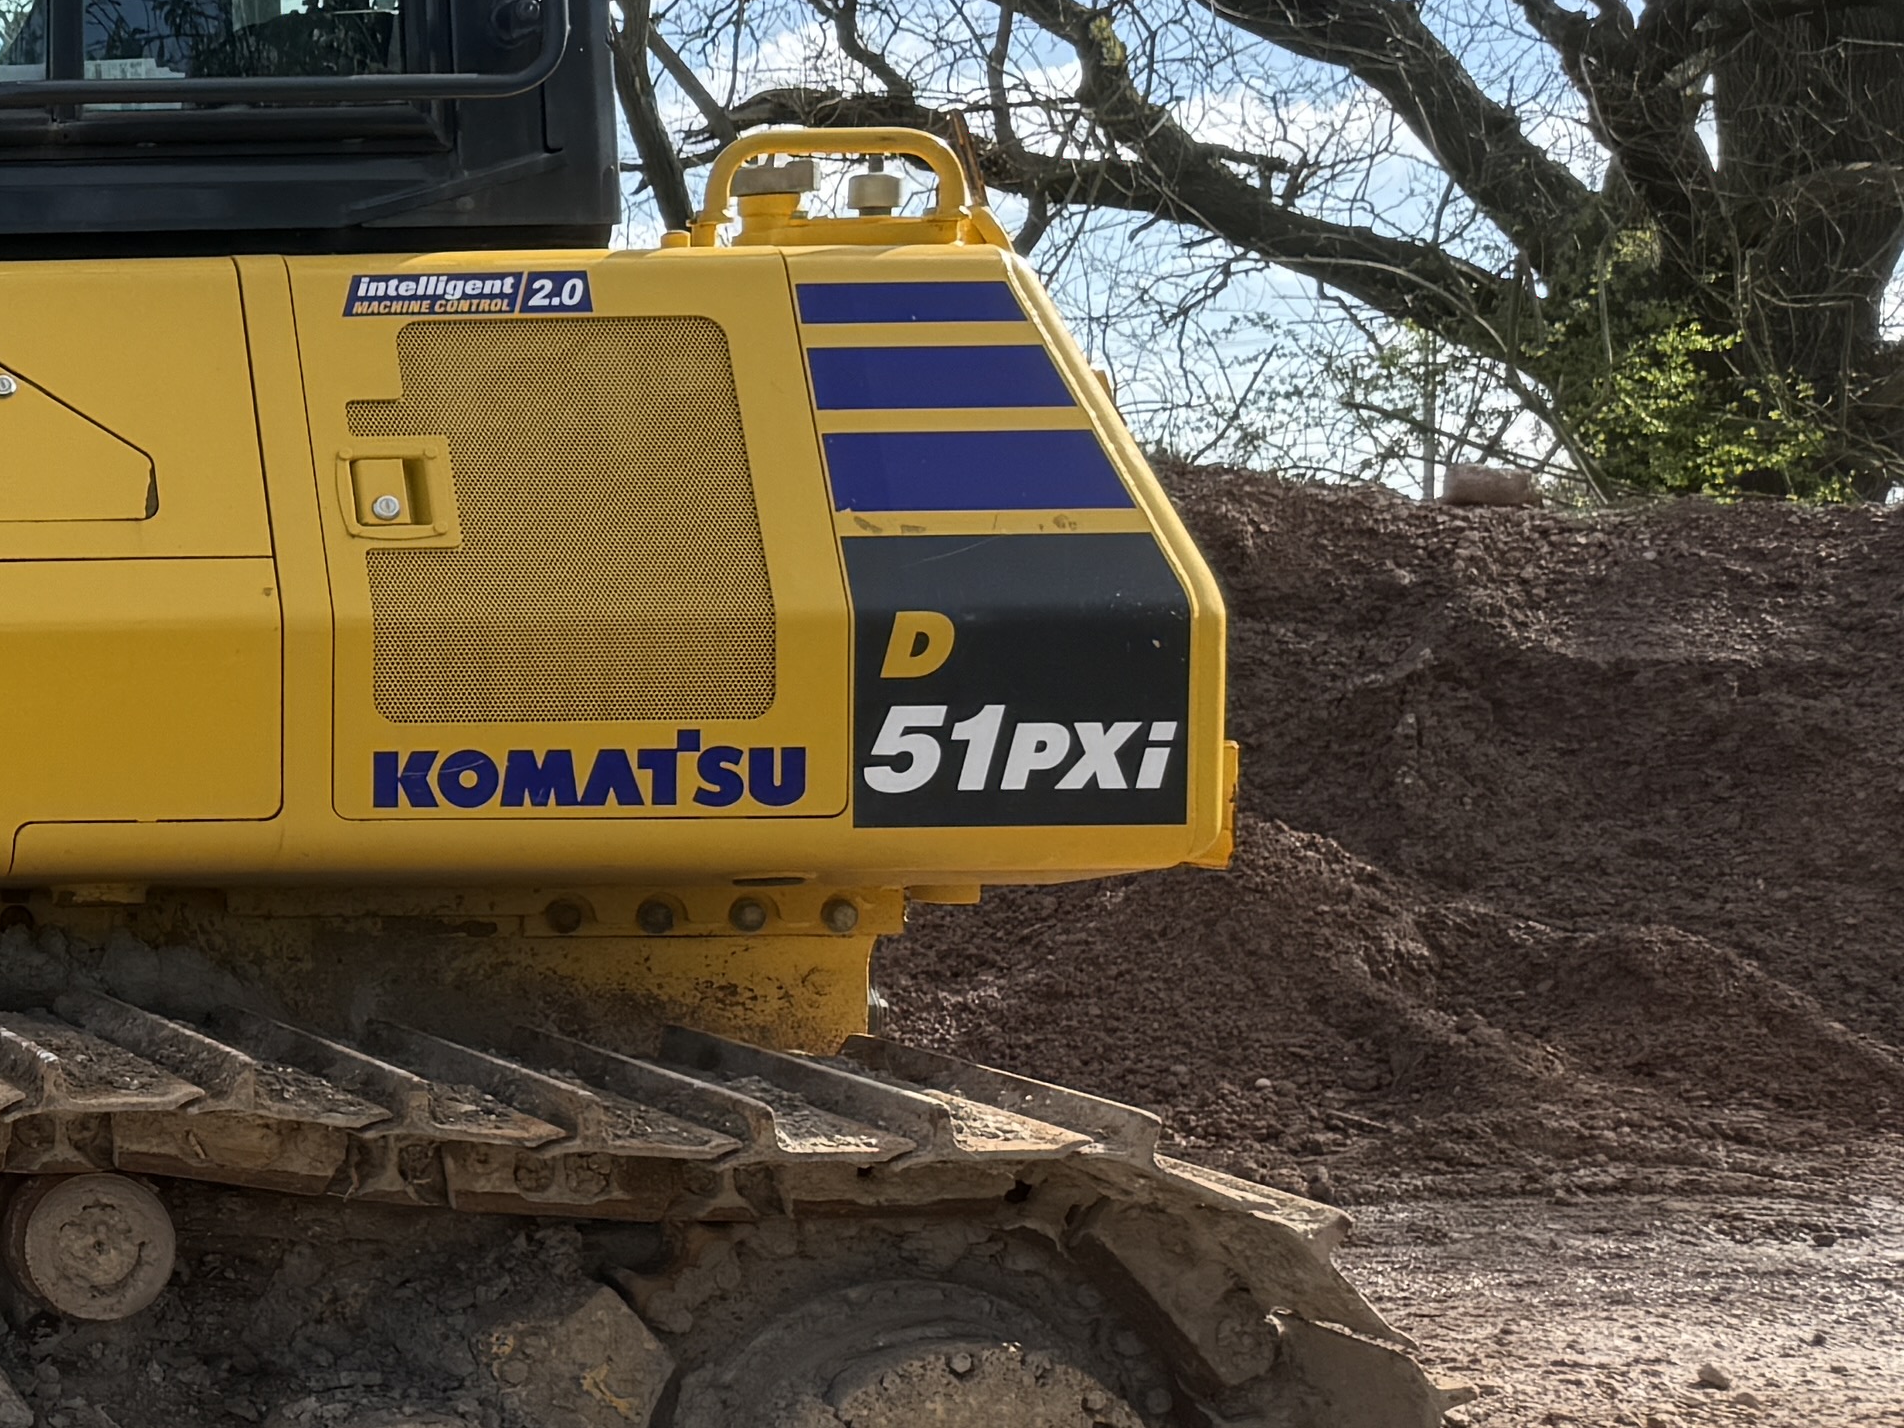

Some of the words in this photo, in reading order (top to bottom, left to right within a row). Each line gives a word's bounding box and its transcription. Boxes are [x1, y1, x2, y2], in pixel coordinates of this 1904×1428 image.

[352, 300, 430, 314] MACHINE
[434, 298, 511, 313] CONTROL
[357, 276, 515, 300] intelligent
[527, 277, 584, 307] 2.0
[879, 610, 955, 679] D
[372, 728, 807, 808] KOMATSU
[861, 702, 1177, 794] 51PXi
